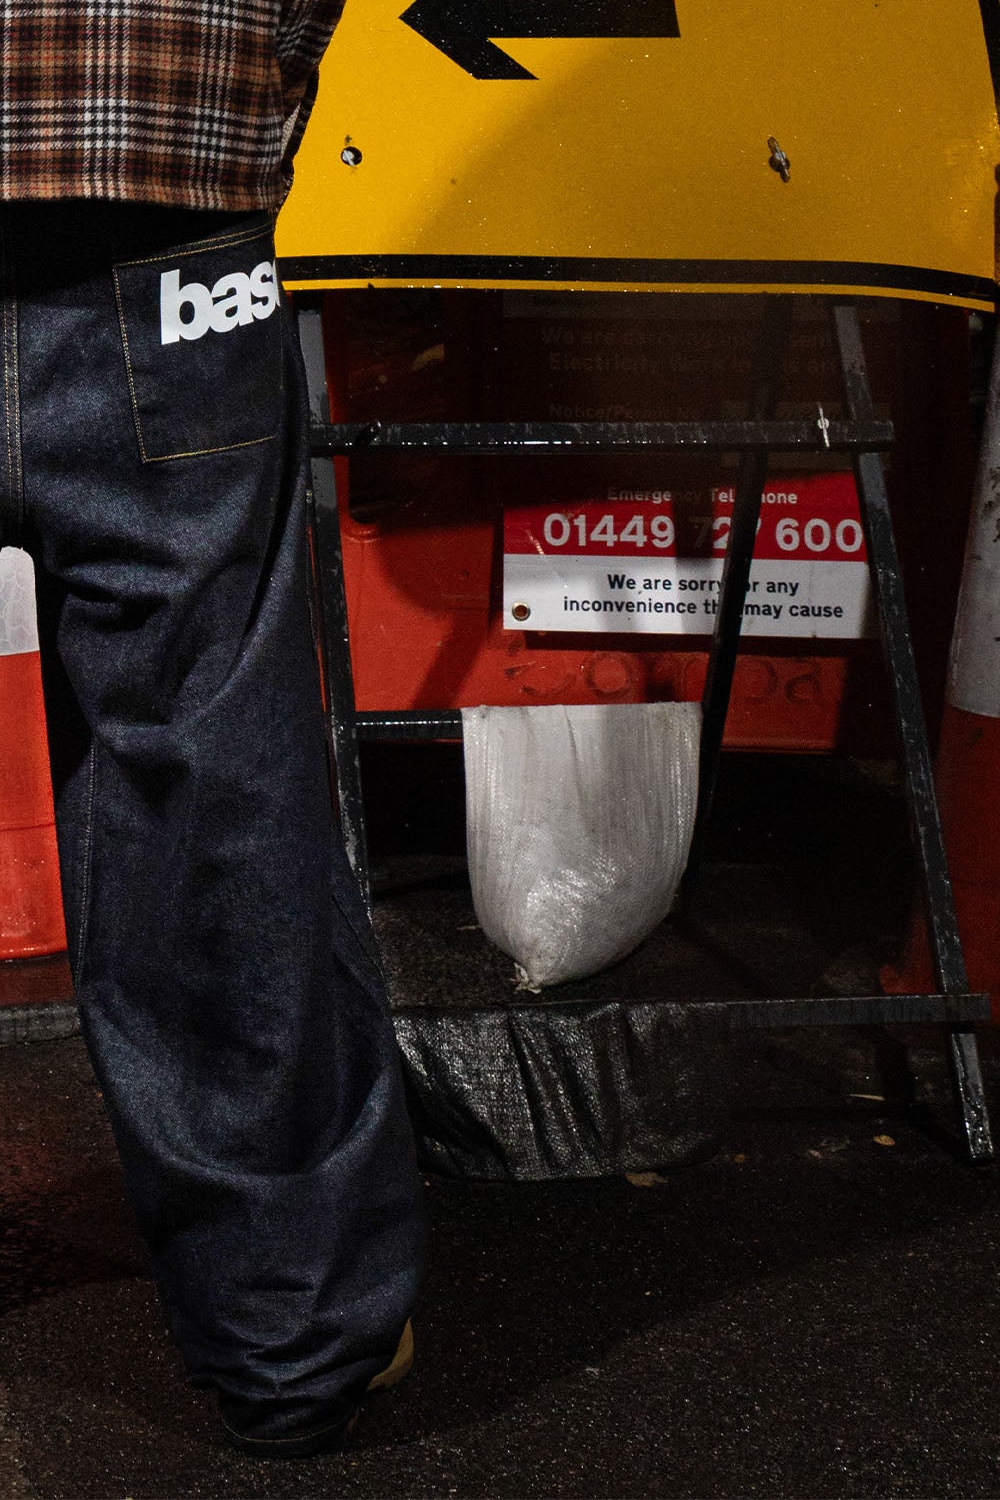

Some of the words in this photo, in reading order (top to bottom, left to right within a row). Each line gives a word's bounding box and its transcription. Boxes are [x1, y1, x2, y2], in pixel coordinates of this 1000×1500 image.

[160, 260, 281, 346] bas
[543, 513, 675, 549] 01449
[775, 518, 864, 553] 600
[607, 573, 636, 590] We
[643, 577, 672, 591] are
[767, 581, 799, 597] any
[563, 595, 697, 614] inconvenience
[745, 603, 783, 620] may
[790, 604, 844, 618] cause
